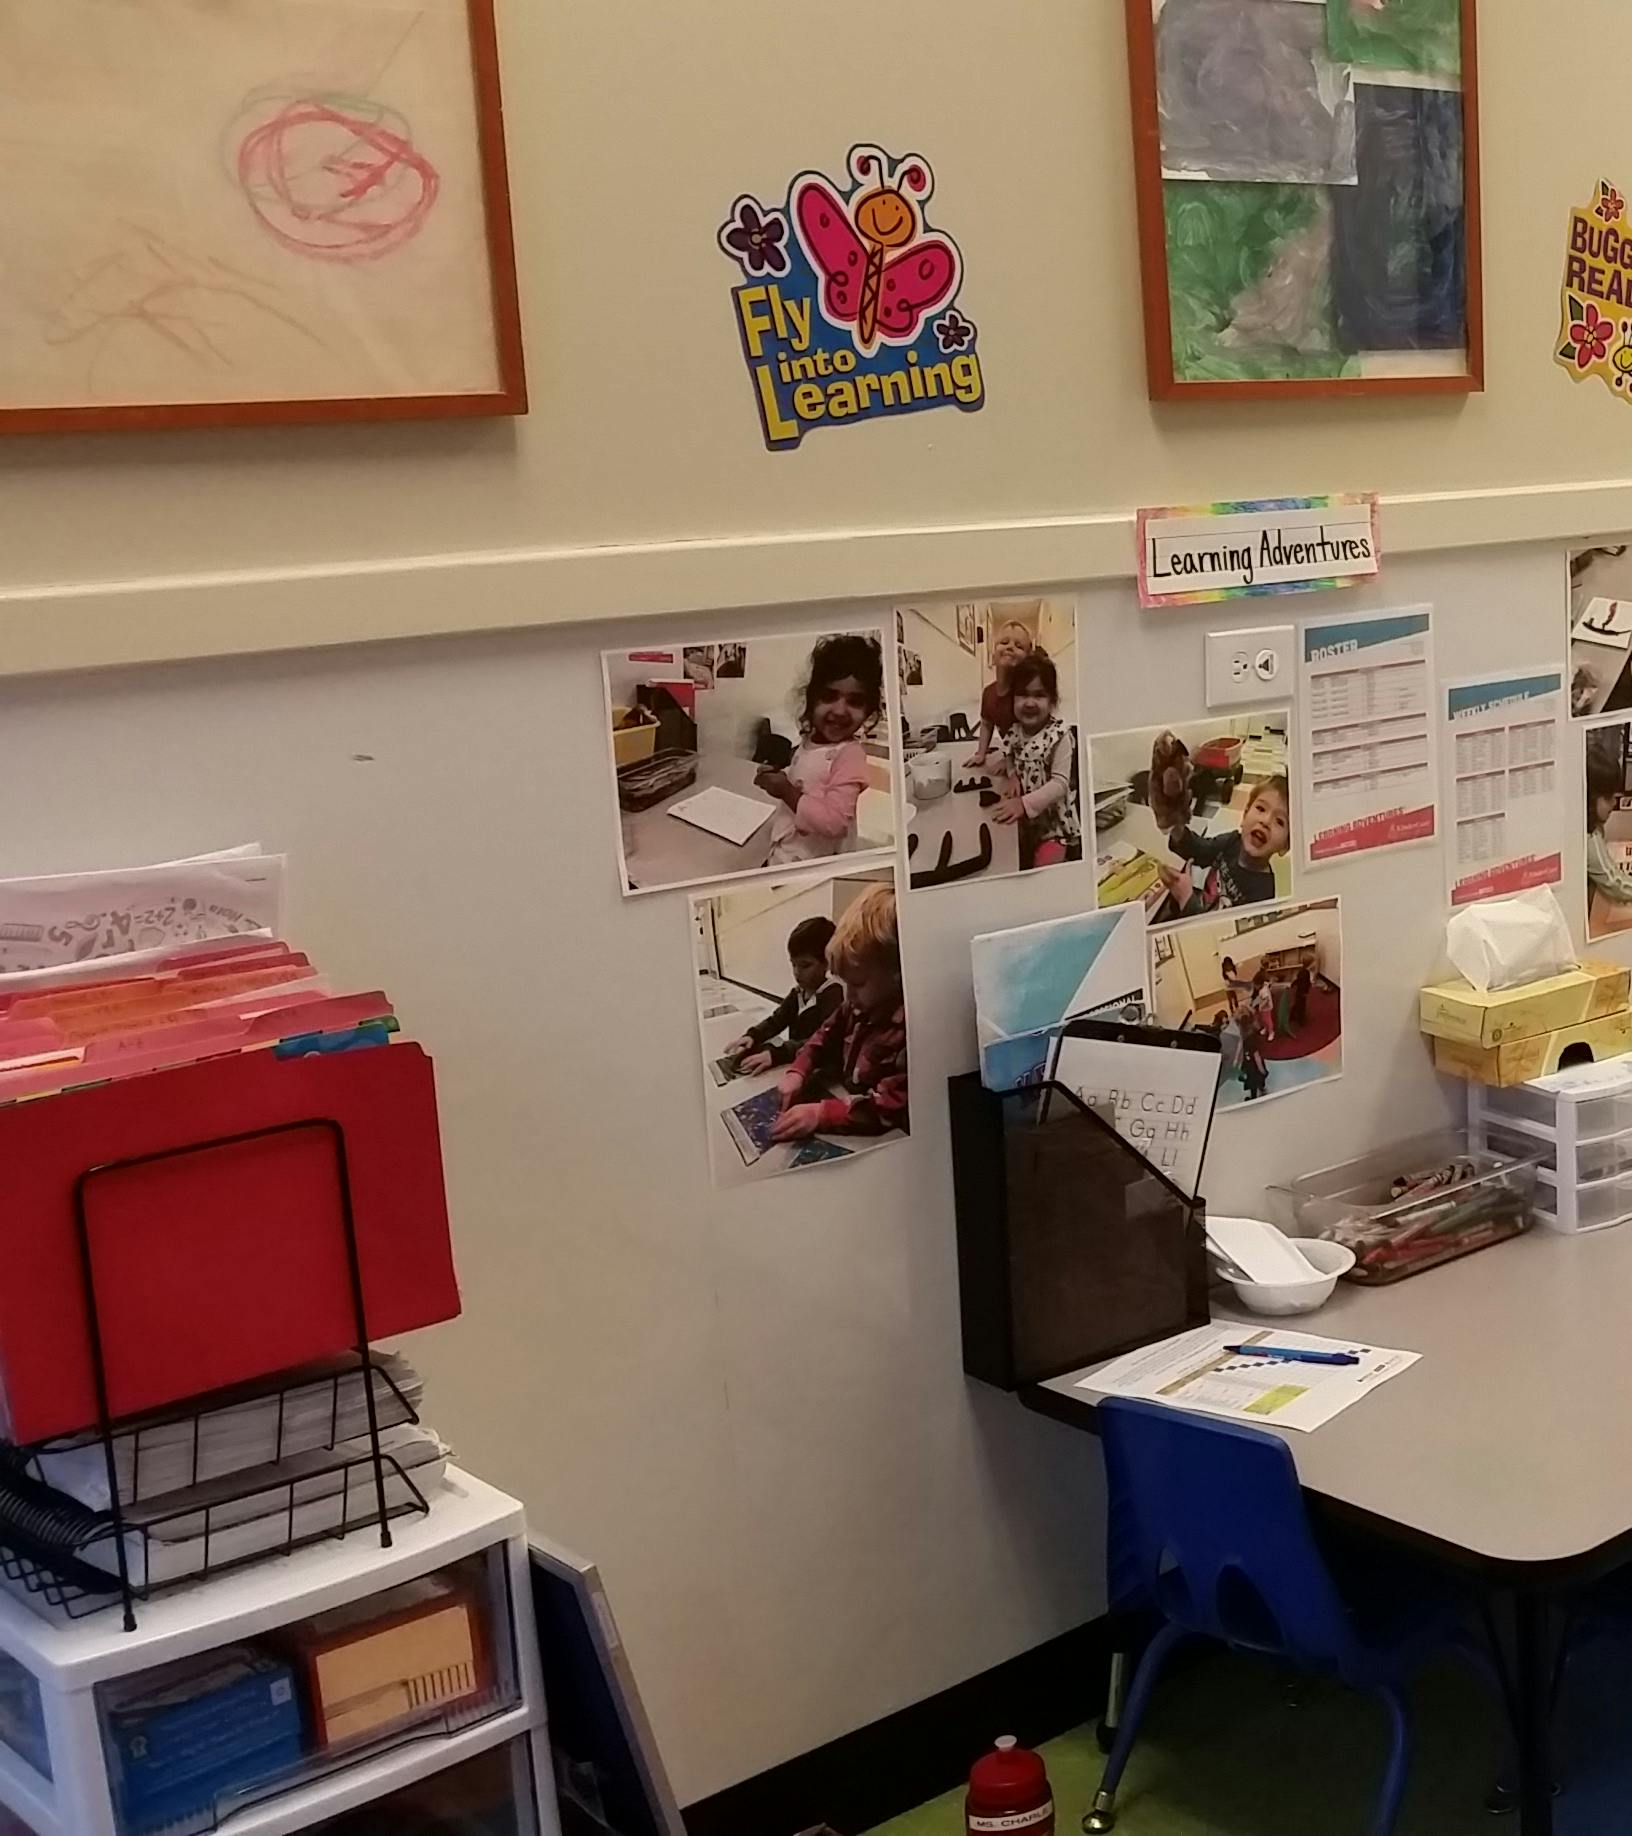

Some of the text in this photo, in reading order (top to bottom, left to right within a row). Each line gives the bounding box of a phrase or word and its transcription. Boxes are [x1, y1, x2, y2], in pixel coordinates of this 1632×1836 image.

[737, 283, 811, 358] Fly
[776, 347, 857, 384] into
[755, 350, 983, 442] Learning
[1152, 525, 1371, 585] Learning Adventures
[1311, 638, 1358, 662] ROSTER
[1171, 1095, 1198, 1115] Dd
[1165, 1121, 1189, 1141] Hh
